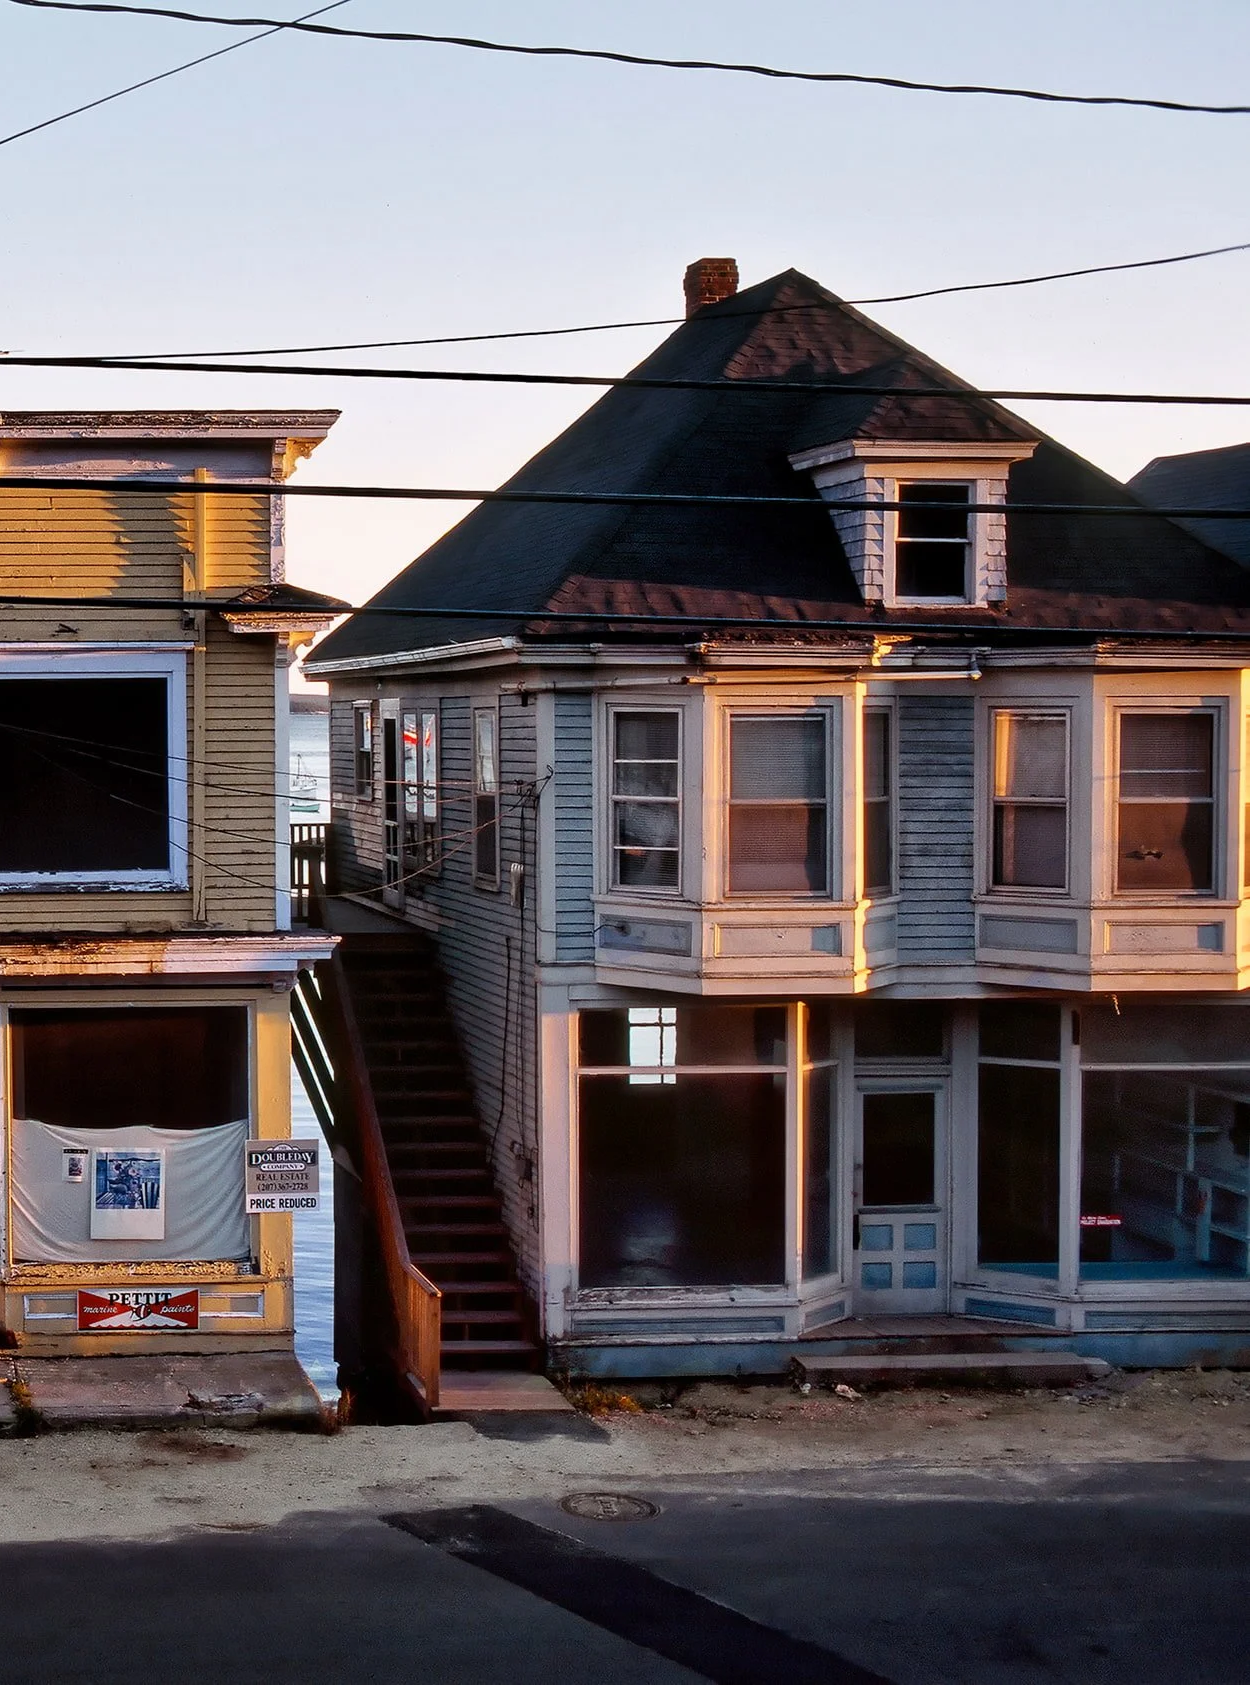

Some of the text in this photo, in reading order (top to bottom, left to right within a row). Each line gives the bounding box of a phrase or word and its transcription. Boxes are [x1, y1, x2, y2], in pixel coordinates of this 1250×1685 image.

[252, 1152, 314, 1165] DOUBLEDAY
[256, 1172, 310, 1181] REAL ESTATE
[250, 1197, 317, 1209] PRICE REDUCED
[108, 1292, 173, 1306] PETTIT
[83, 1303, 195, 1314] marine paints
